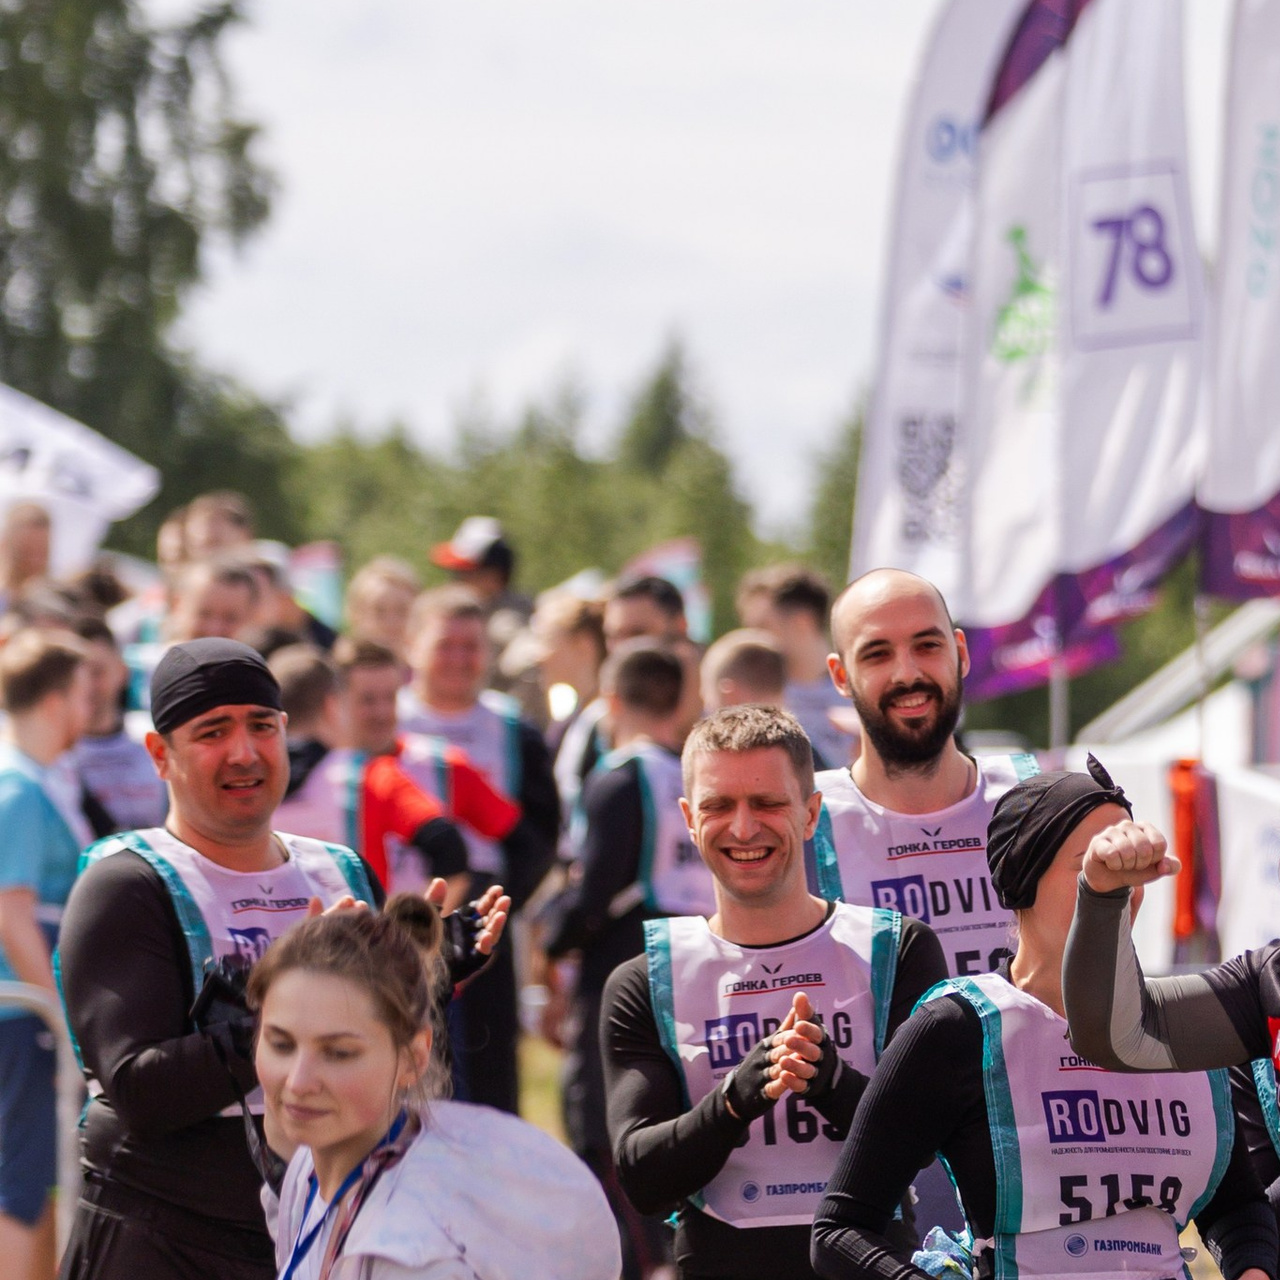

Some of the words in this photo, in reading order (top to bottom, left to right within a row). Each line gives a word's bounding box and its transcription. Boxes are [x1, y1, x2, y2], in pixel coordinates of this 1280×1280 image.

[1090, 203, 1174, 314] 78
[887, 842, 931, 857] ГОНКА
[933, 837, 982, 850] ГЕРОЕВ
[876, 876, 992, 920] RODVI
[726, 979, 769, 994] ГОНКА
[772, 972, 823, 988] ГЕРОЕВ
[1049, 1098, 1191, 1138] RODVIG
[1094, 1238, 1163, 1257] ГАЗПРОМБАНК
